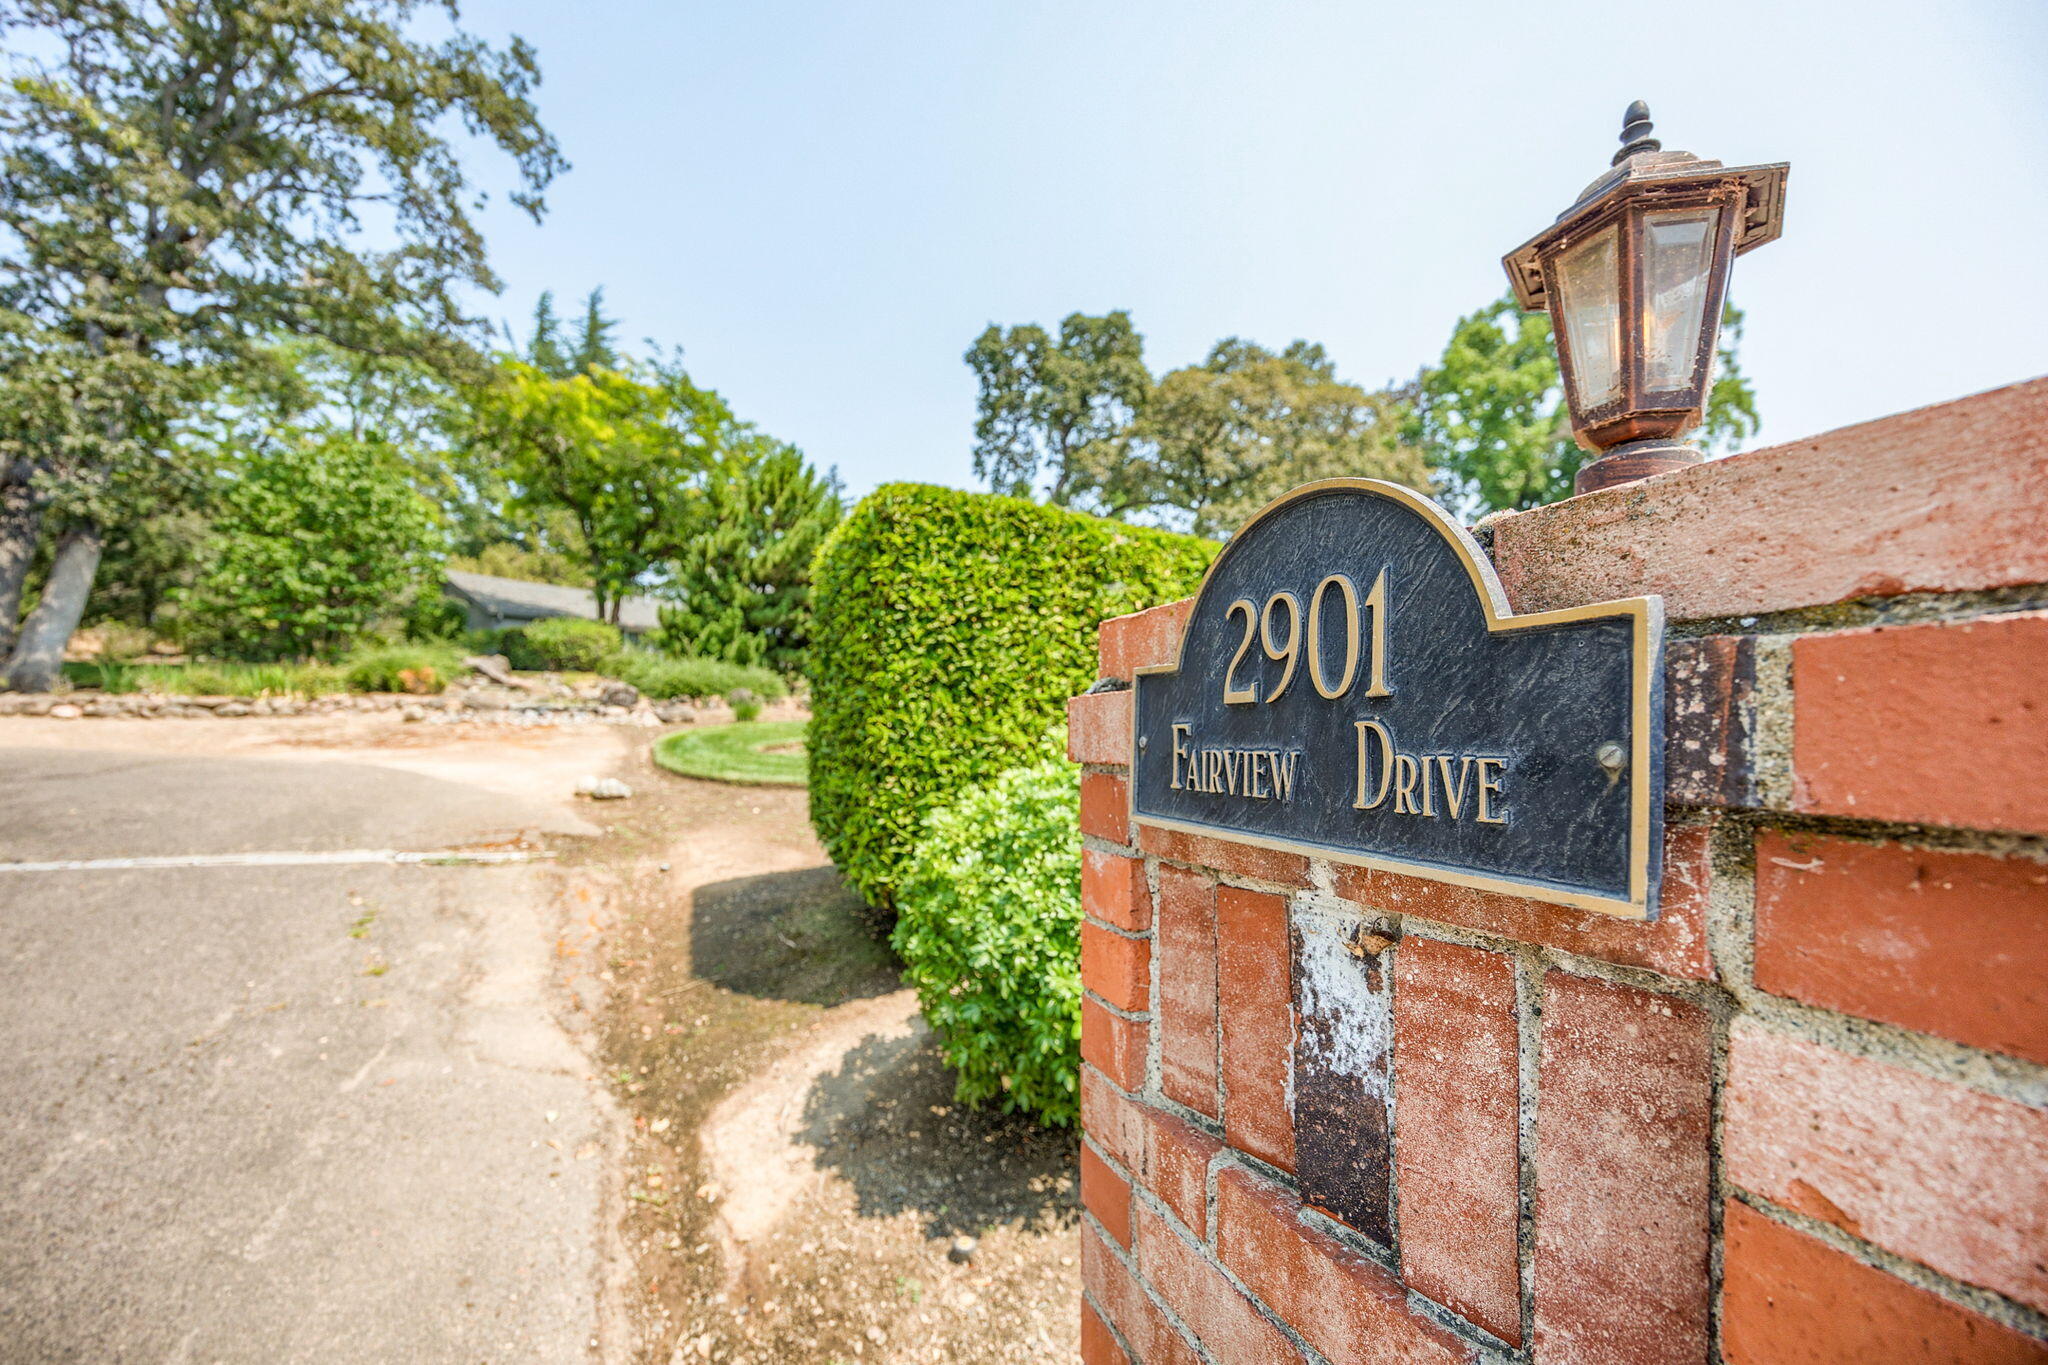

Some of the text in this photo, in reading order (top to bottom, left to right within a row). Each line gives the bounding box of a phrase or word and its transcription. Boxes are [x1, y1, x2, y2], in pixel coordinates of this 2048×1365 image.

[1223, 565, 1395, 705] 2901
[1170, 717, 1509, 824] FAIRVIEW DRIVE
